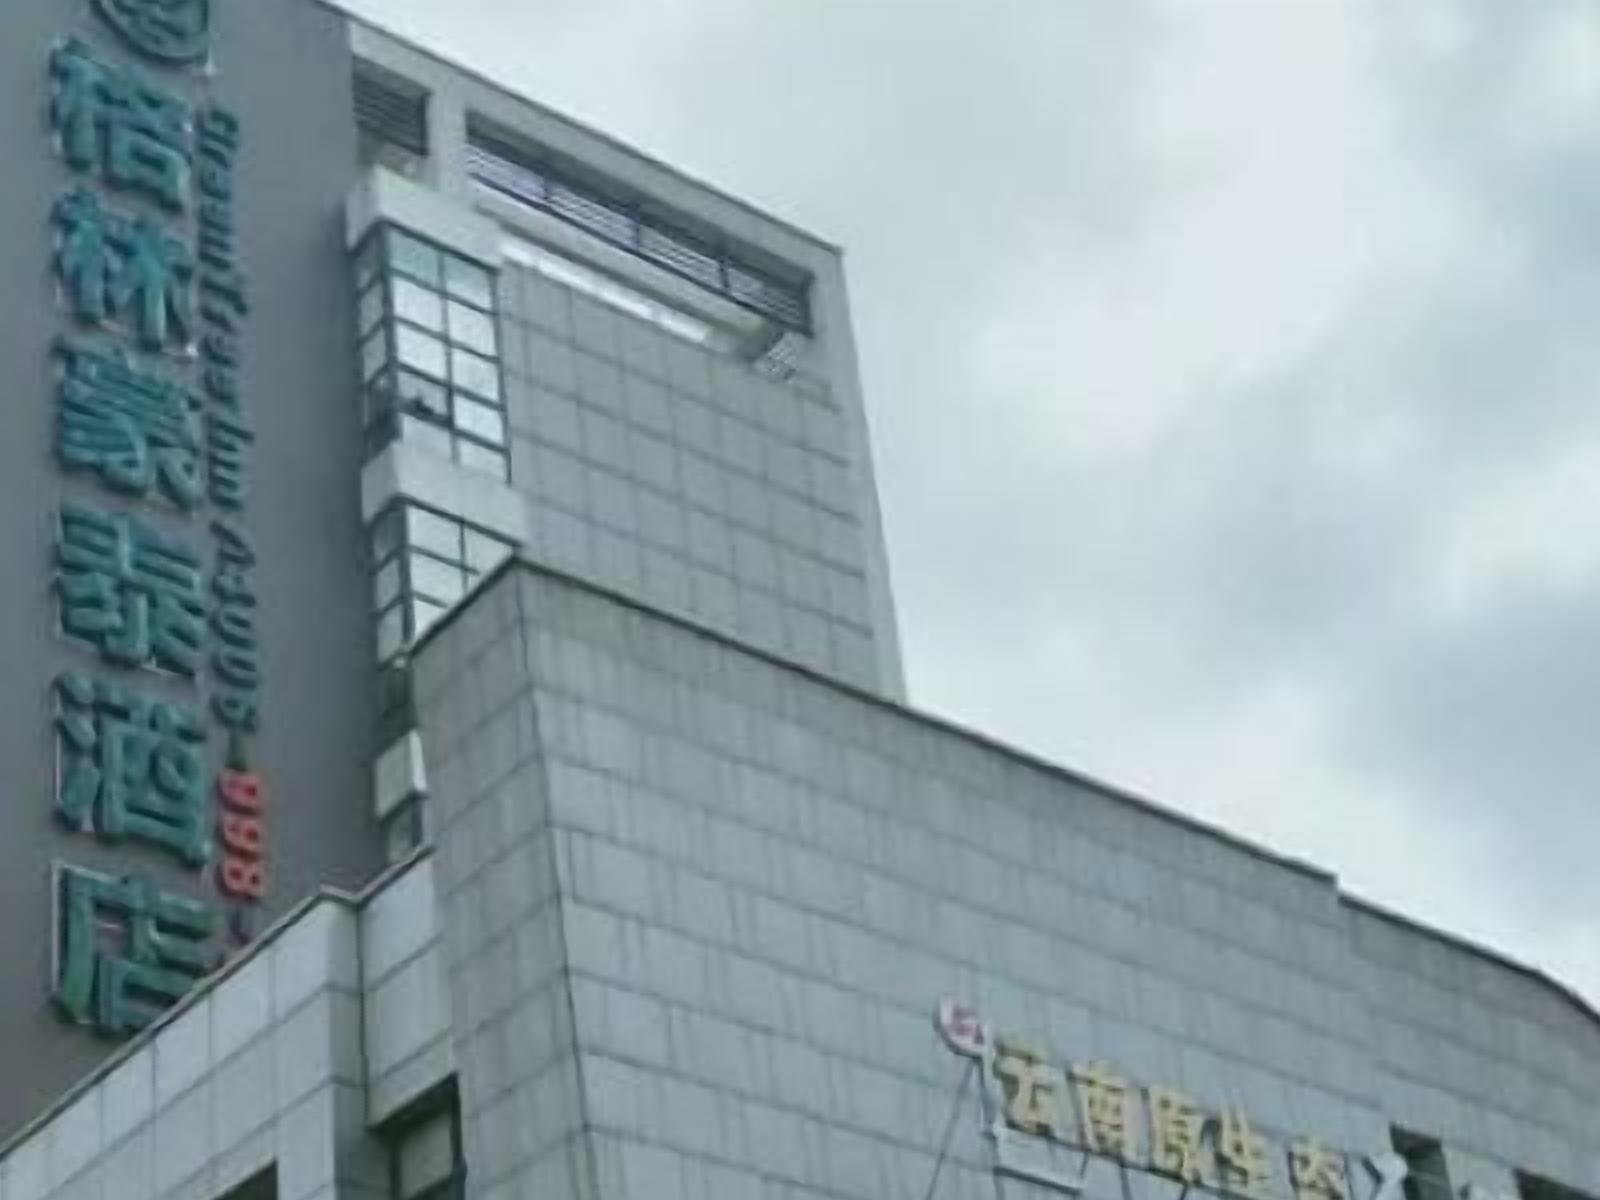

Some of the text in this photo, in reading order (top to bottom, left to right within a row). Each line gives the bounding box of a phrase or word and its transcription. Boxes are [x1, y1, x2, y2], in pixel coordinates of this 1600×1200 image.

[50, 38, 223, 1038] 格林豪泰酒店
